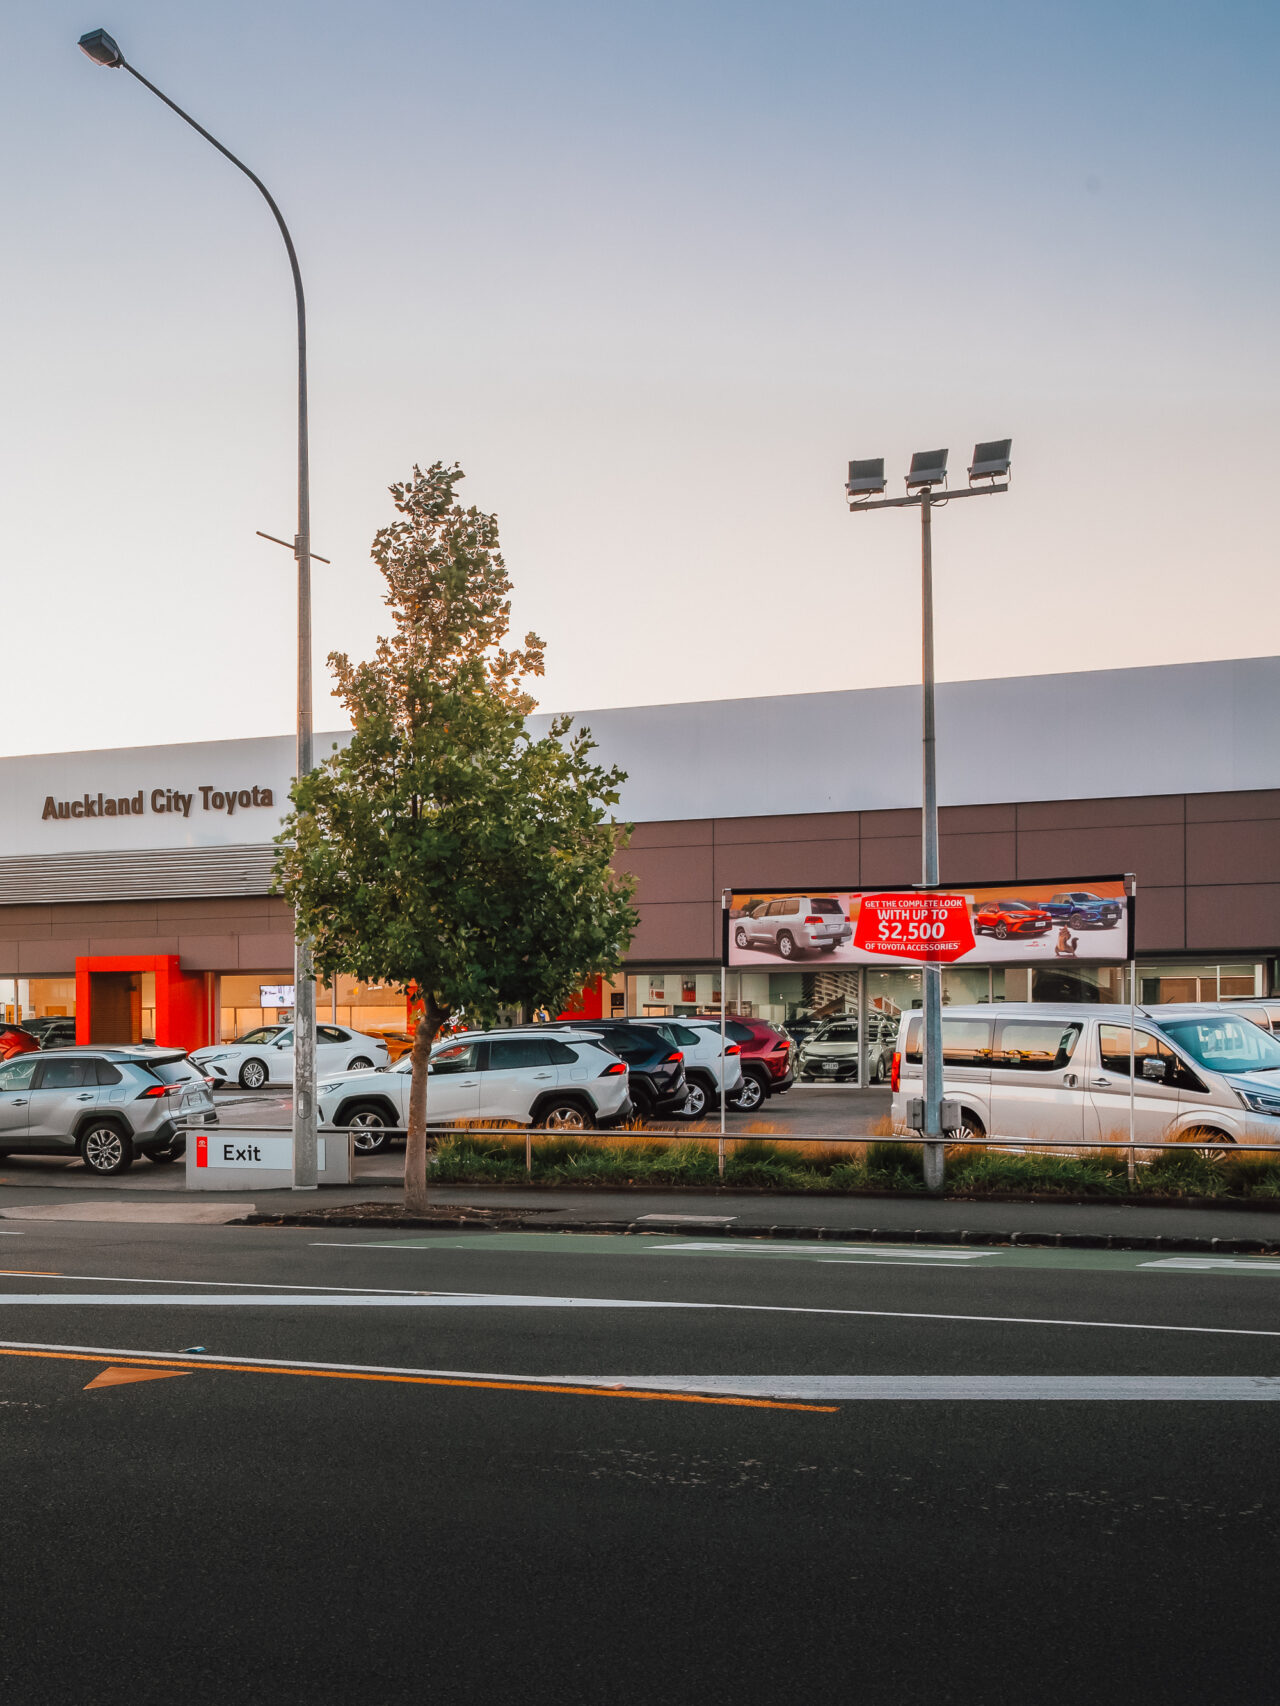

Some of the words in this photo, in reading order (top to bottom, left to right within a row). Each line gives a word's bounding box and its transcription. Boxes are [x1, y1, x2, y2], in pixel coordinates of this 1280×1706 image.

[41, 790, 144, 821] Auckland
[150, 788, 193, 818] City
[198, 785, 274, 816] Toyota
[865, 900, 879, 908] GET
[939, 899, 963, 907] LOOK
[877, 909, 910, 920] WITH
[912, 909, 928, 920] UP
[931, 909, 948, 920] TO
[878, 920, 945, 942] $2,500
[876, 943, 906, 951] TOYOTA
[223, 1144, 262, 1162] Exit
